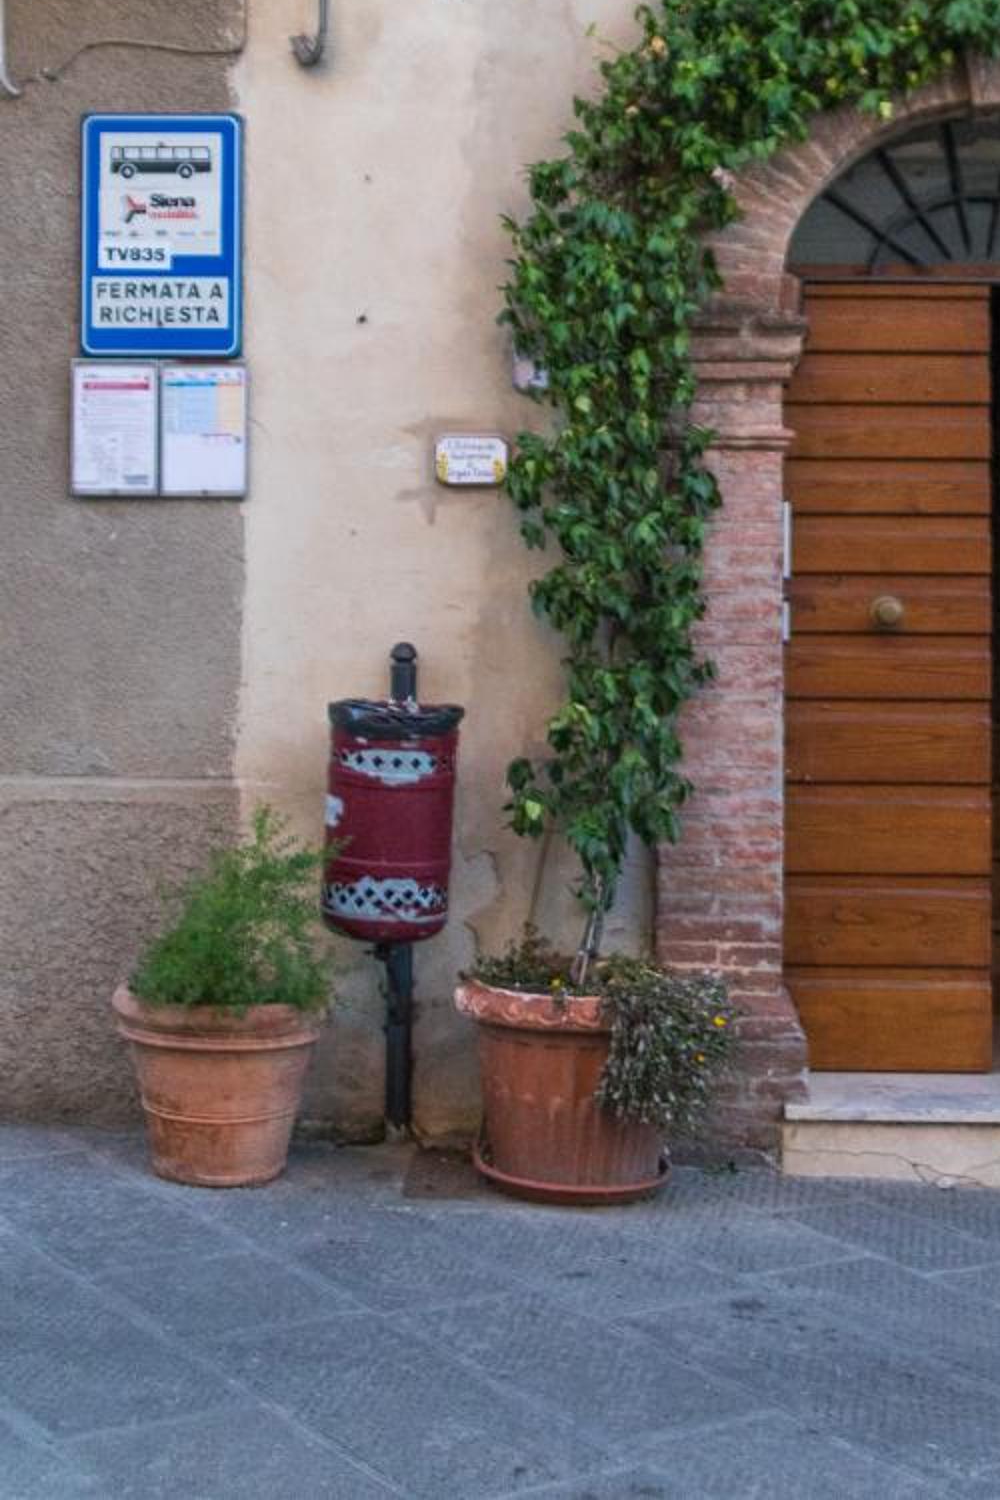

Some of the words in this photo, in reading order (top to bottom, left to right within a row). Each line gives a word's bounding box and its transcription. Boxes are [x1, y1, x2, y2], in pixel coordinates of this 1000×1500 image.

[96, 282, 201, 299] FERMATA
[209, 282, 224, 299] A
[100, 306, 220, 323] RICHIESTA
